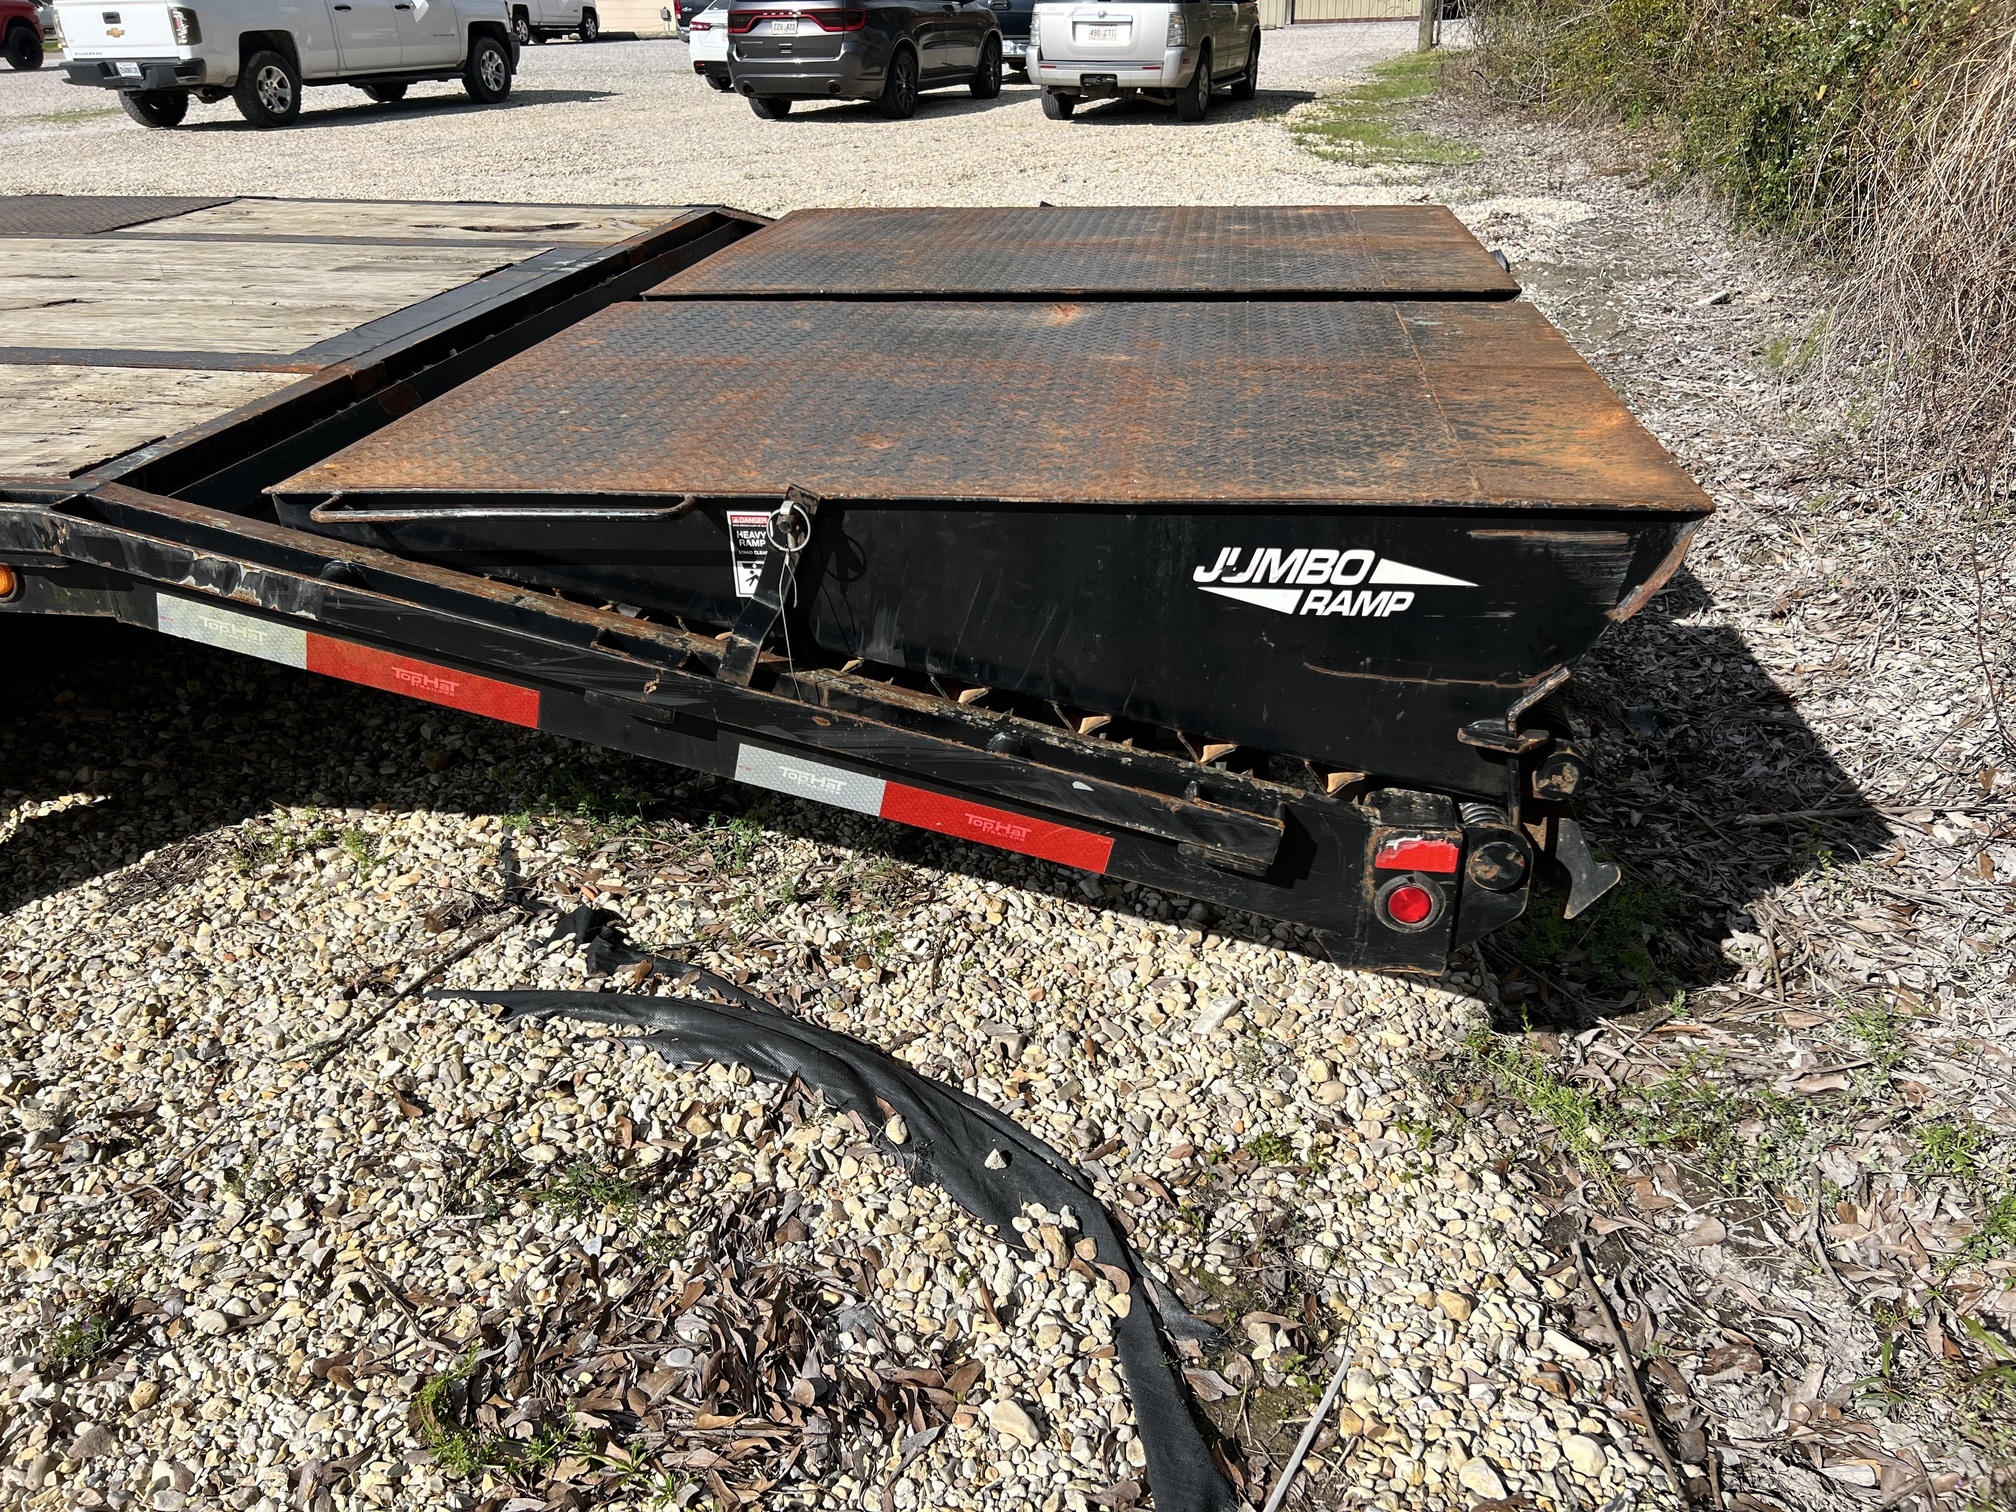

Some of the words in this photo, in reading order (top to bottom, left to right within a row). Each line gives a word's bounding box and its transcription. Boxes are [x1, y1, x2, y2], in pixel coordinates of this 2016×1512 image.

[736, 530, 767, 539] HEAVY
[739, 539, 766, 547] RAMP
[1192, 546, 1376, 586] JUMBO
[1299, 589, 1415, 618] RAMP
[415, 683, 455, 697] TRAILERS
[986, 829, 1025, 842] TRAILERS
